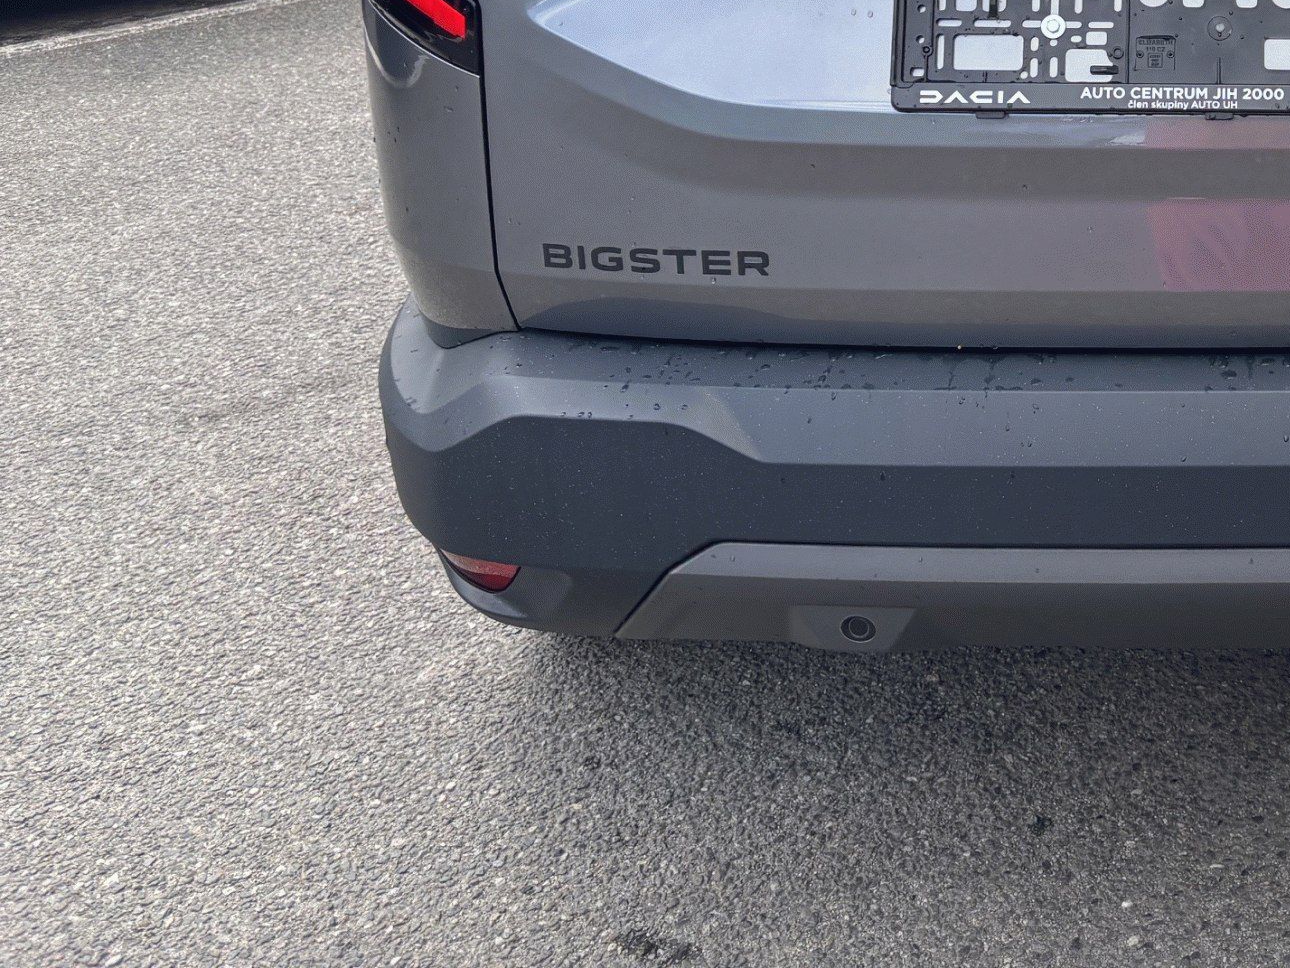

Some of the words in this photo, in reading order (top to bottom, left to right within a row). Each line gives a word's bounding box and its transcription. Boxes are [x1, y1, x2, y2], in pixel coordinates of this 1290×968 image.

[919, 89, 1031, 104] DACIA
[1080, 87, 1126, 100] AUTO
[1130, 87, 1208, 100] CENTRUM
[1213, 87, 1238, 101] JIH
[1242, 88, 1285, 101] 2000
[1127, 99, 1148, 109] člen
[1151, 99, 1189, 111] skupiny
[1191, 100, 1221, 109] AUTO
[1223, 100, 1238, 109] UH
[542, 242, 770, 277] BIGSTER
